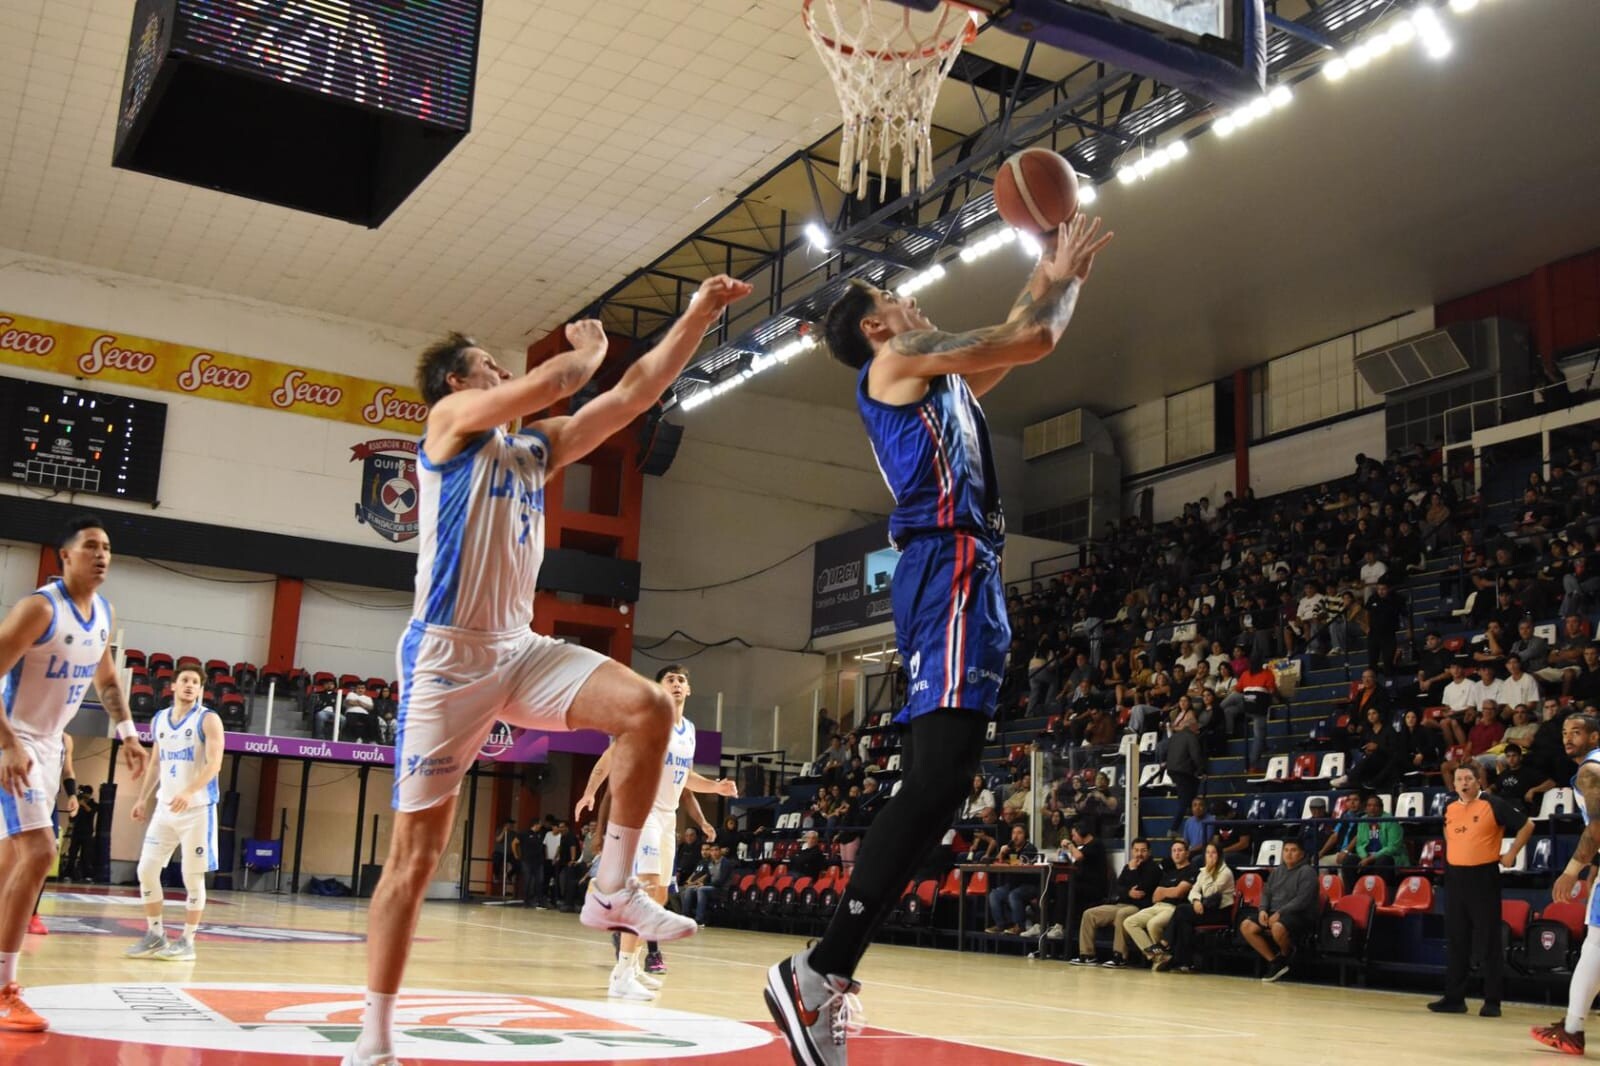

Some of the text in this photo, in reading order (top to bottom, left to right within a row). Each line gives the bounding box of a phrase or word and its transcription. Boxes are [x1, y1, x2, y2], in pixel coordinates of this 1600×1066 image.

[79, 336, 154, 374] Secco
[178, 353, 250, 391] Secco
[272, 371, 341, 407] Secco
[363, 388, 429, 423] Secco
[374, 458, 417, 473] QUIMS
[45, 655, 69, 679] LA
[66, 684, 83, 705] 15
[167, 744, 195, 762] UNION
[170, 763, 177, 777] 4
[672, 770, 685, 785] 17
